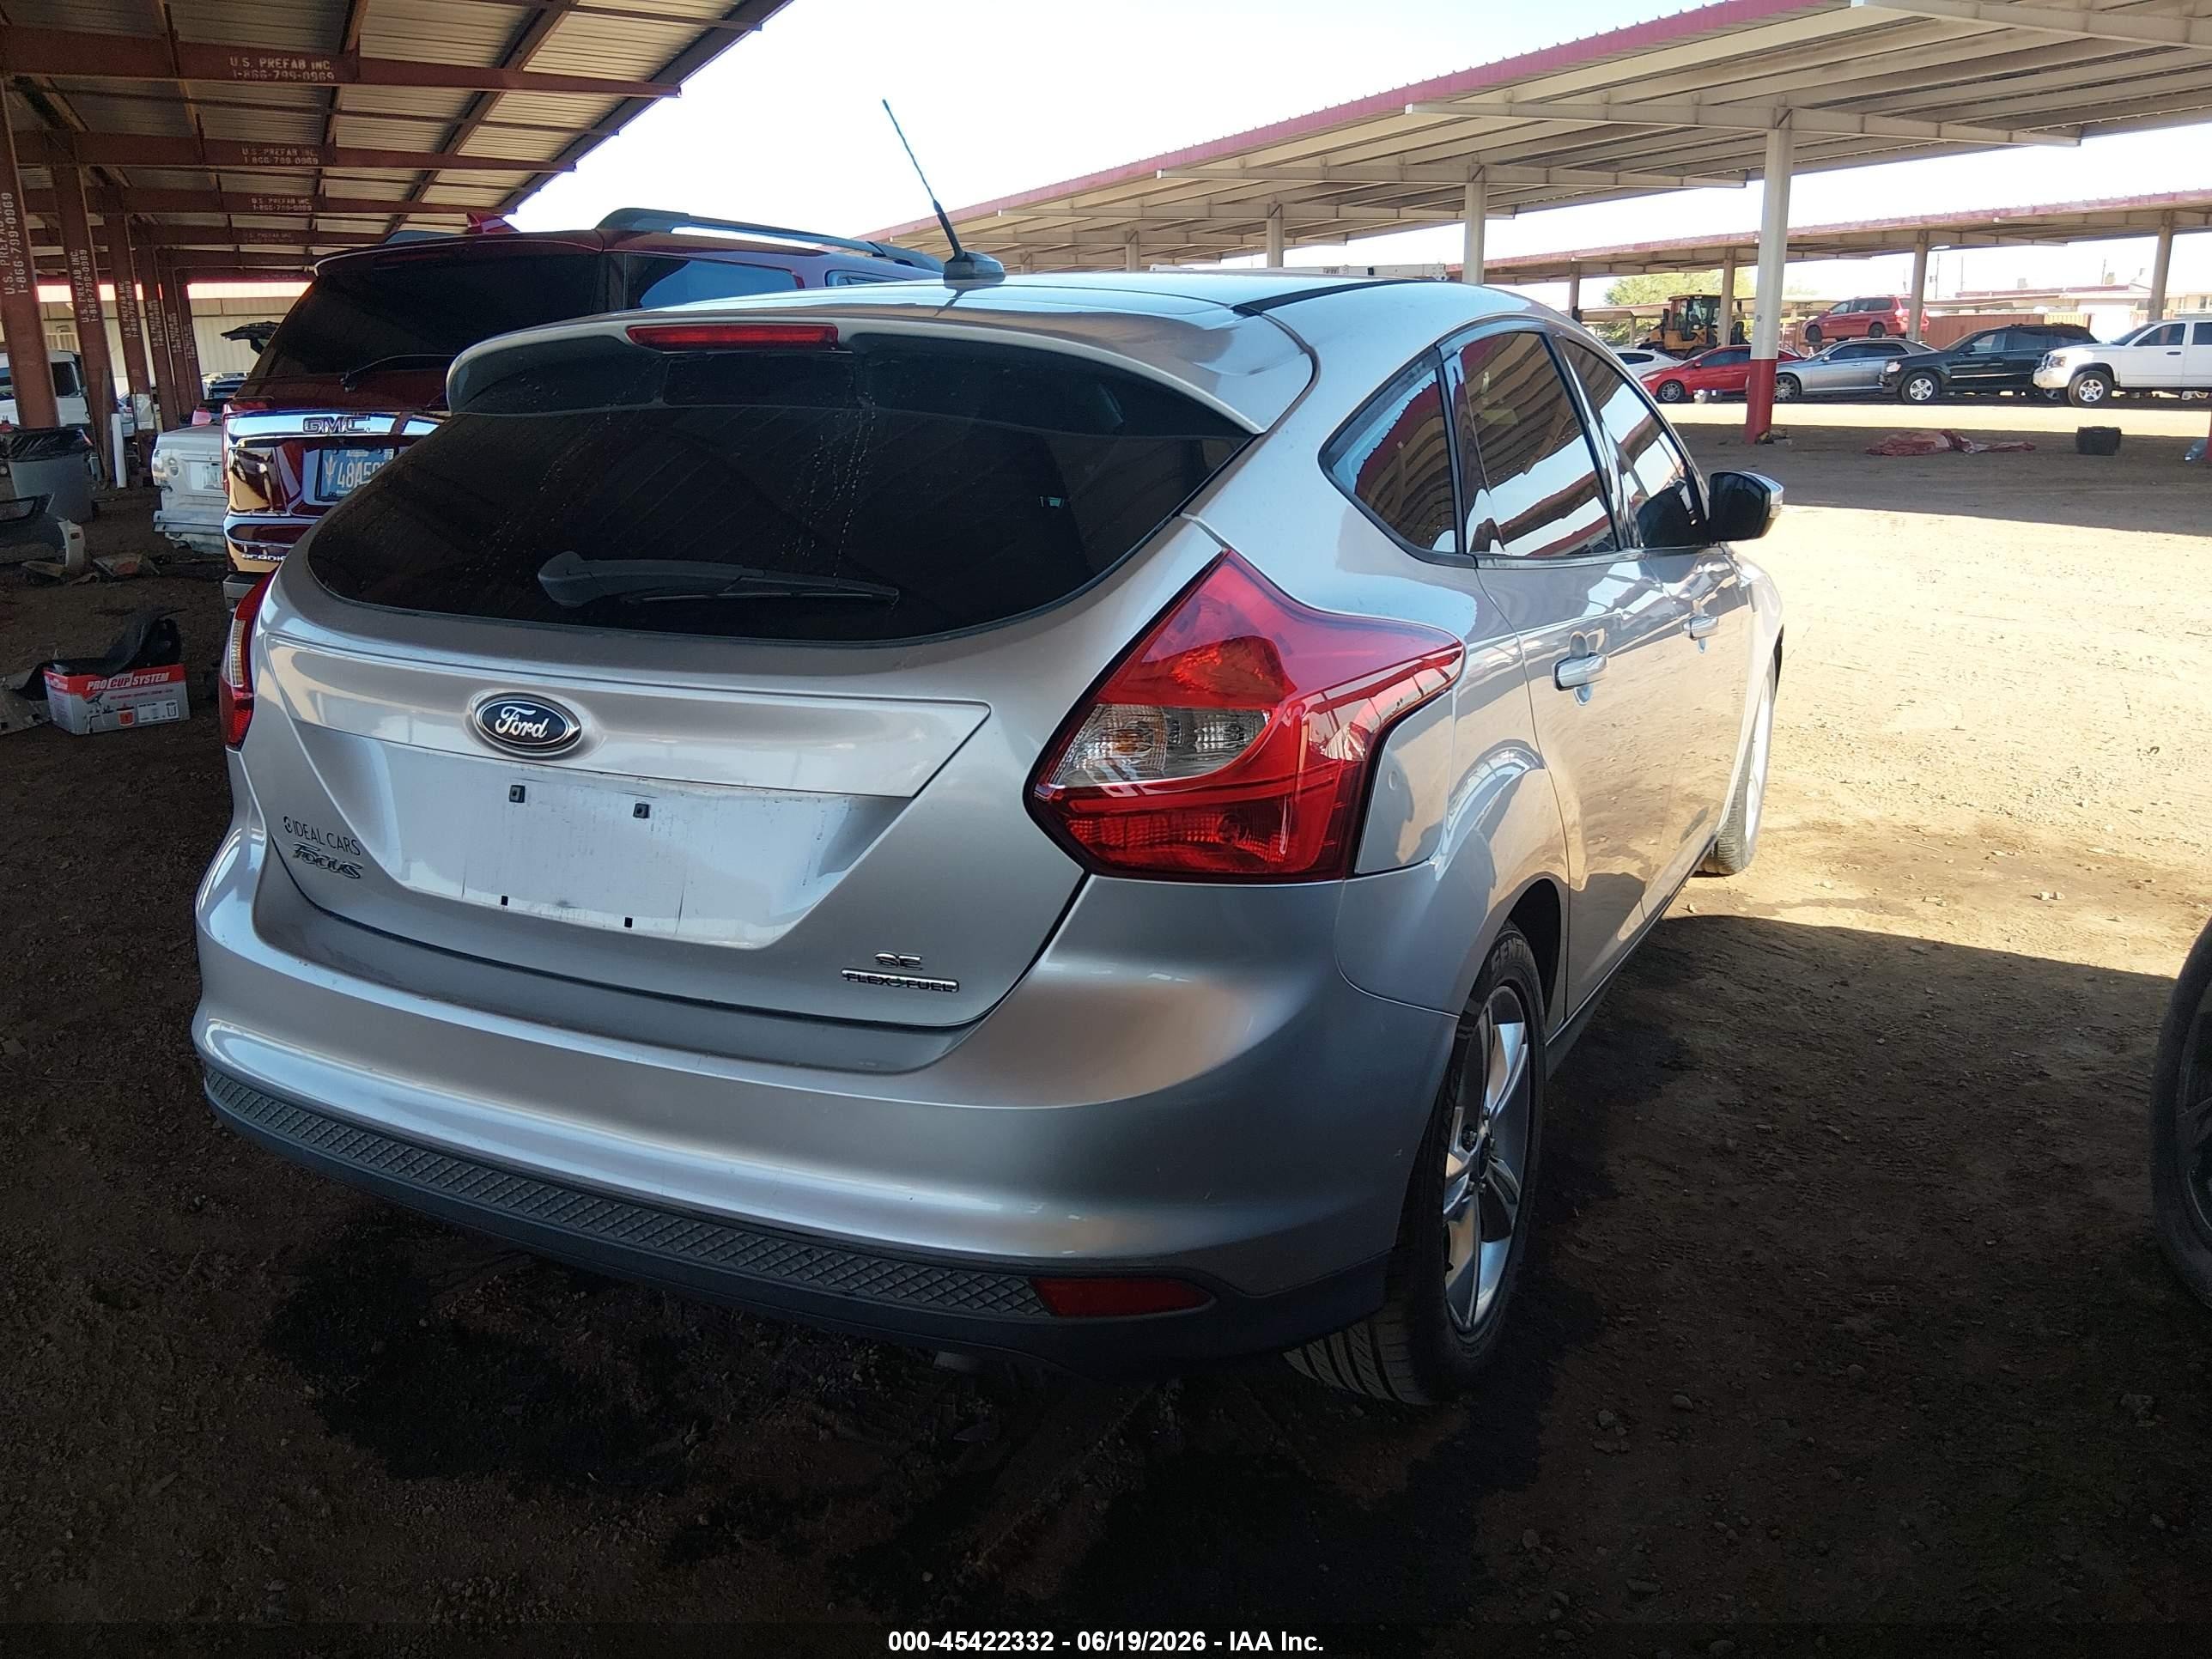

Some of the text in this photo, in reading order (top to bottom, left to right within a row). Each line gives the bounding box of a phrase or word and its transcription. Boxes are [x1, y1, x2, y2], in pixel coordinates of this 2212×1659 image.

[229, 56, 333, 70] U.S. PREFAB INC.
[3, 272, 15, 295] U.S.
[302, 416, 371, 434] GMC
[86, 672, 171, 691] PRO CUP SYSTEM
[495, 706, 550, 738] Ford
[292, 820, 361, 856] IDEAL CARS
[875, 951, 923, 971] SE
[845, 972, 957, 993] FLEX FUEL
